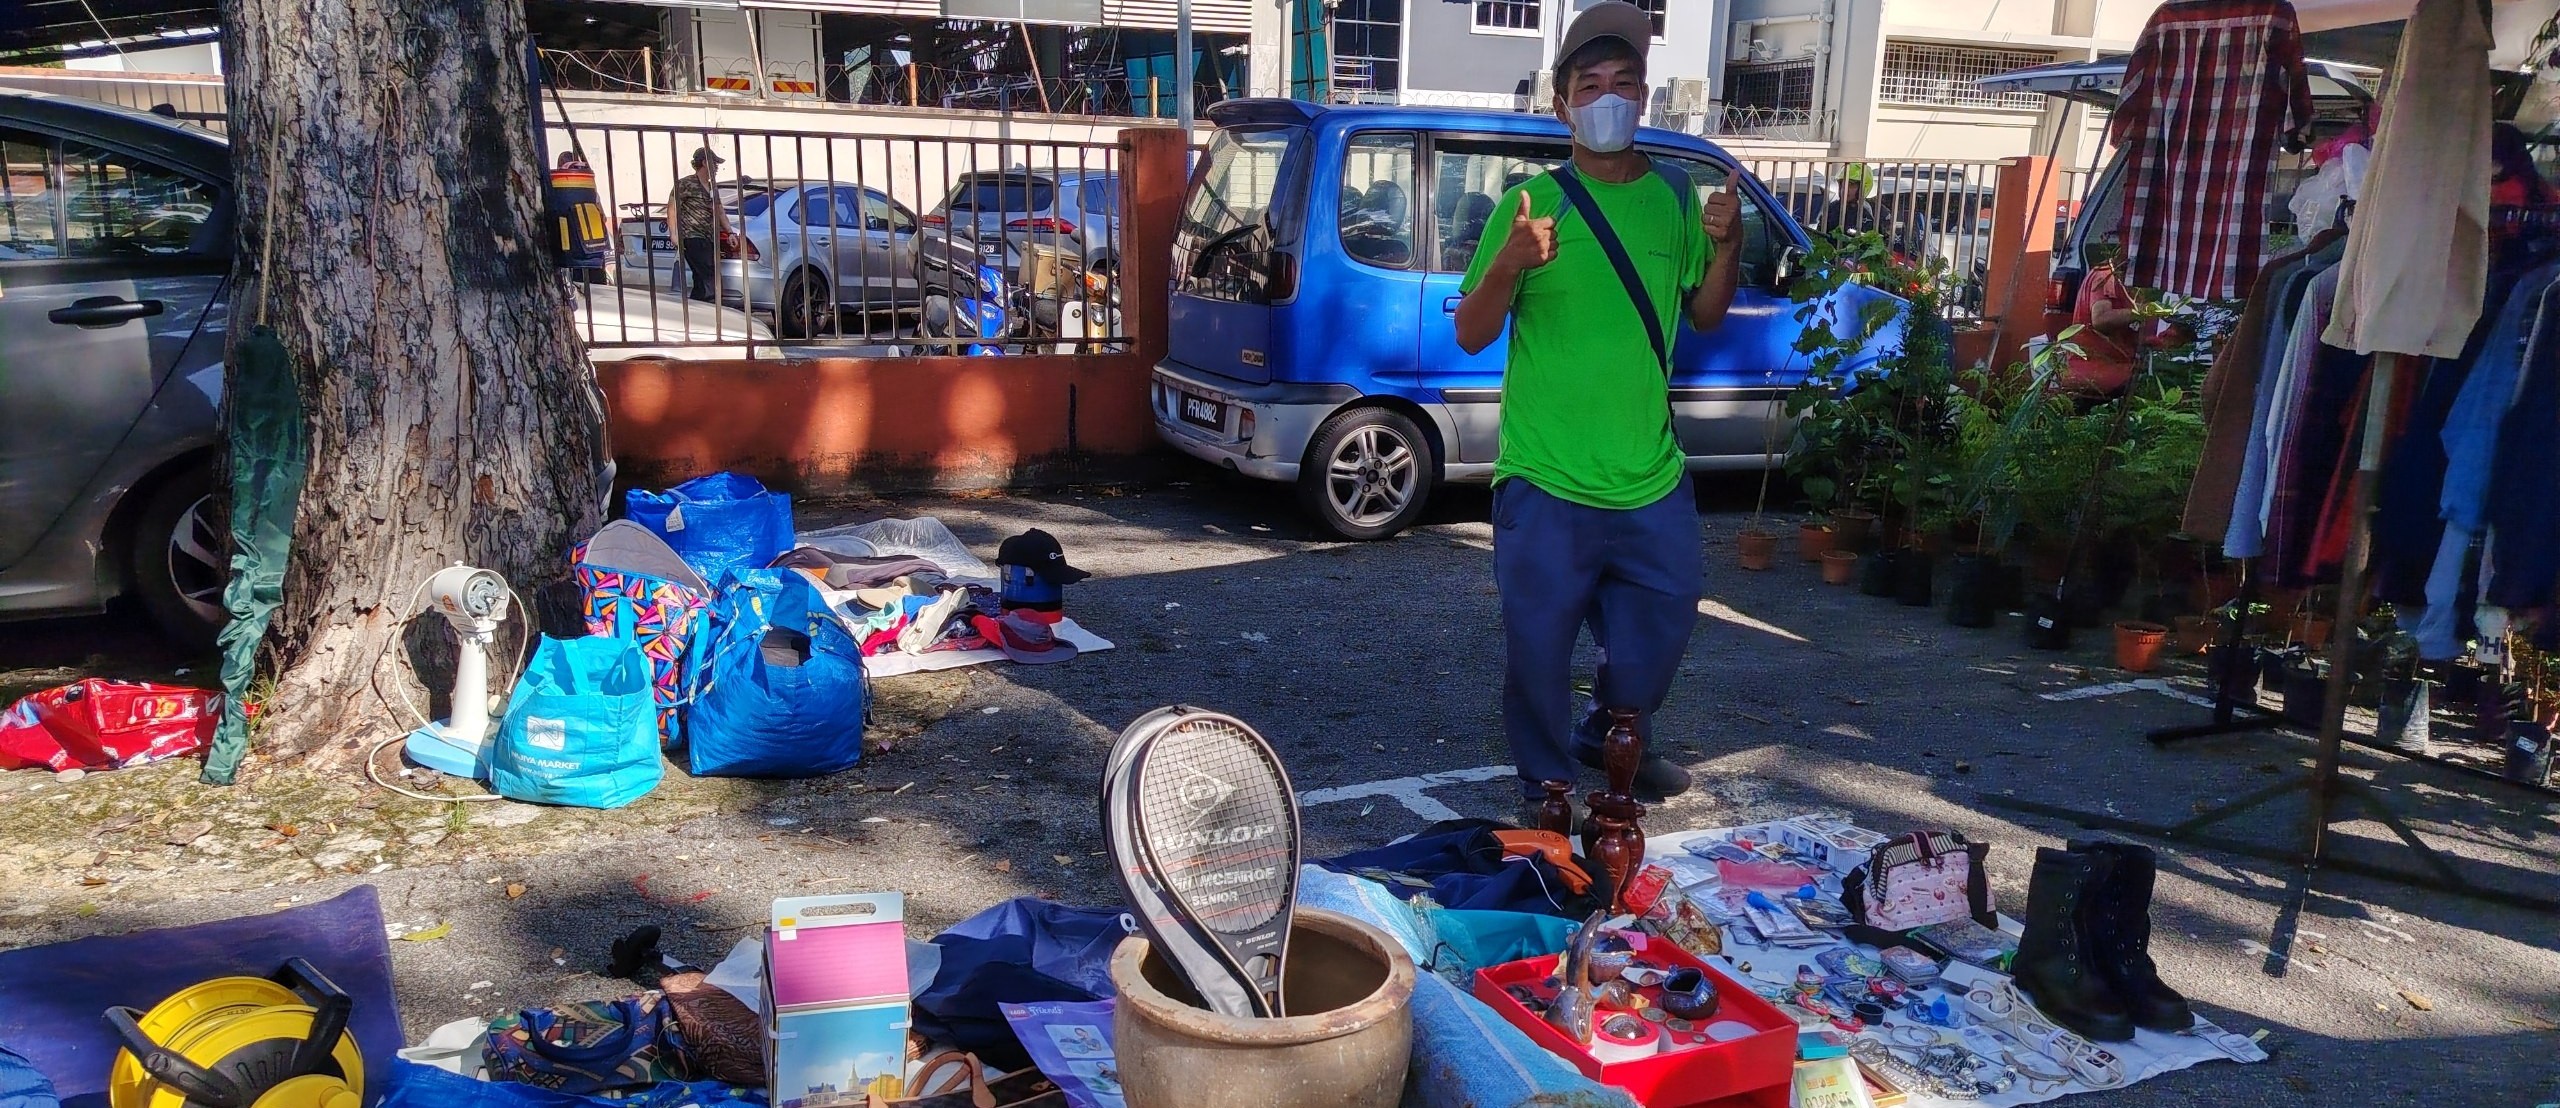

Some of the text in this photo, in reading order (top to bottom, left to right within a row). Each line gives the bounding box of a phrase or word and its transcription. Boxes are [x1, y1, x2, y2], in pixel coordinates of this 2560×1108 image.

[1187, 398, 1217, 423] PFR4882
[537, 759, 581, 770] MARKET
[1199, 867, 1277, 888] MCENROE
[1191, 891, 1239, 907] SENIOR
[1245, 931, 1277, 945] DUNLOP
[1028, 1006, 1063, 1016] Friends
